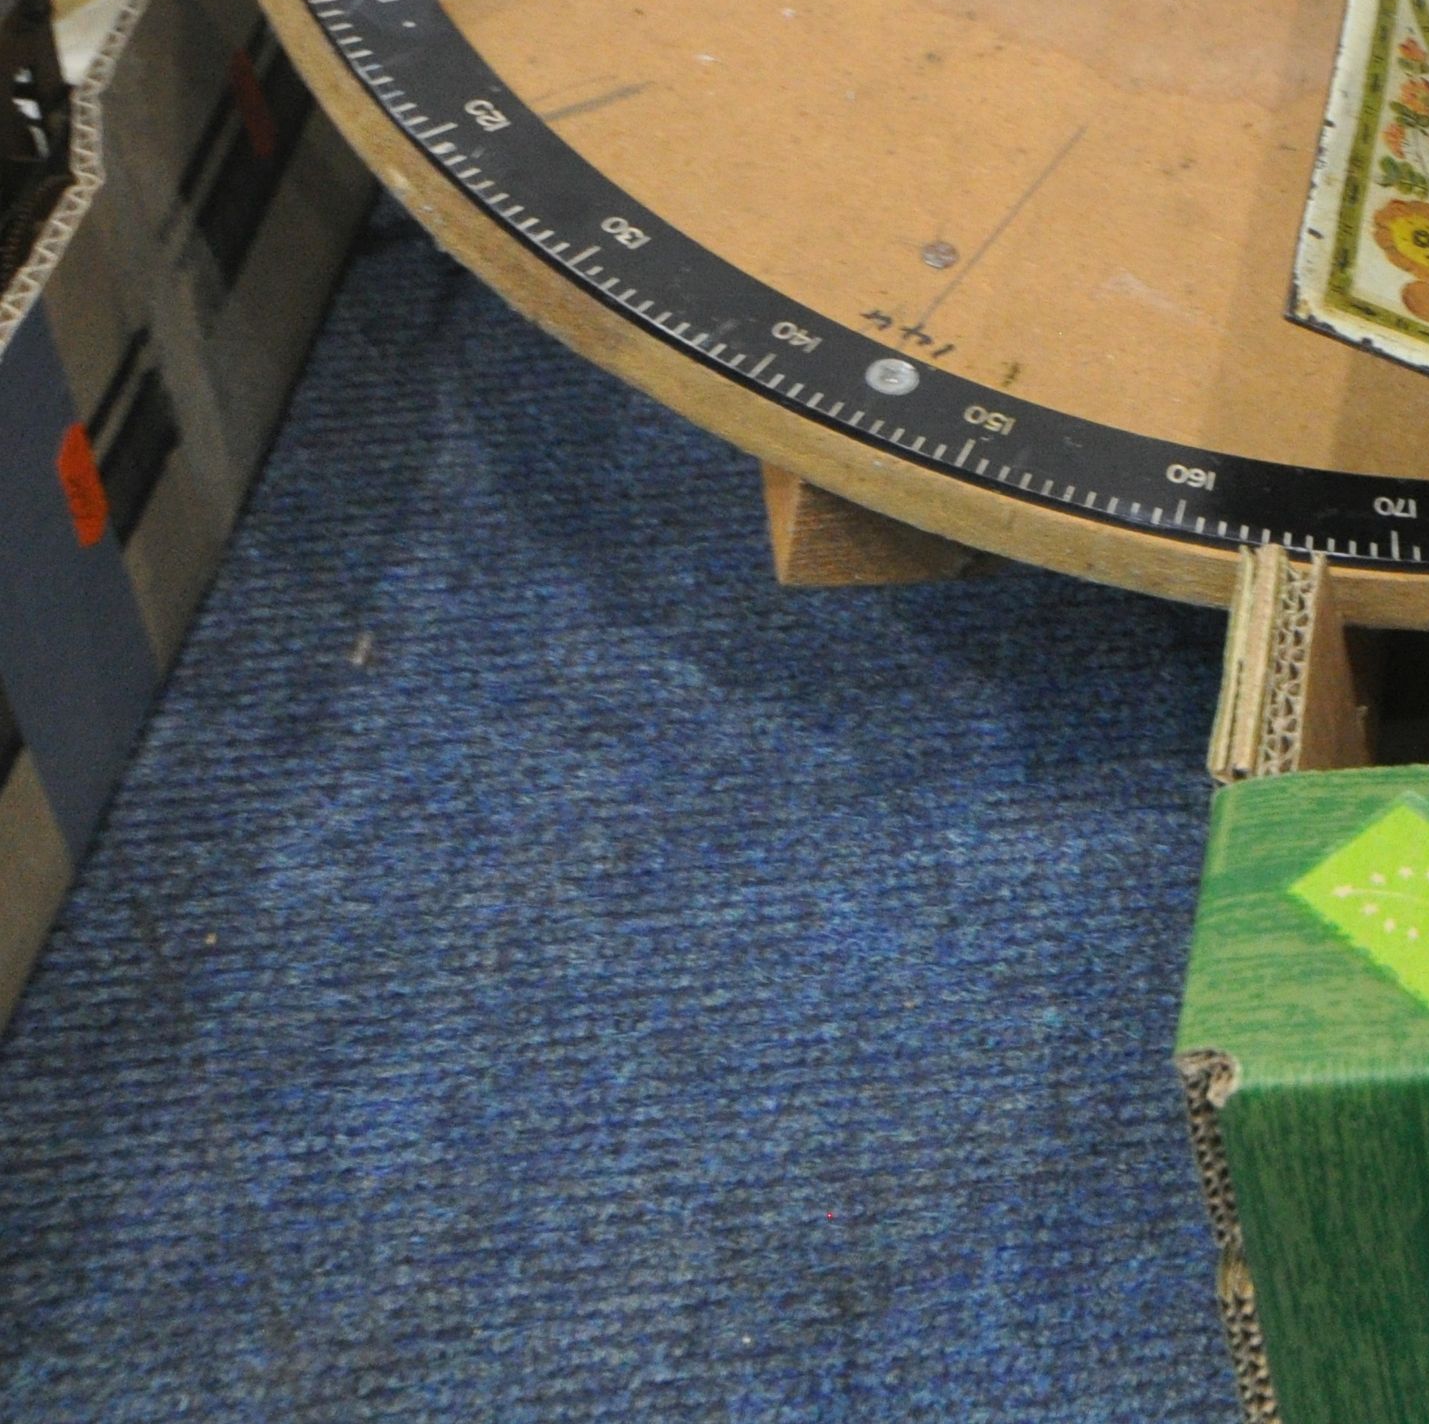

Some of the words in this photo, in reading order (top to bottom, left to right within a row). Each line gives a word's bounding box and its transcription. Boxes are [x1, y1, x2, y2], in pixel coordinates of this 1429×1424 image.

[463, 98, 512, 133] 120
[600, 216, 652, 252] 130
[770, 320, 824, 354] 140
[963, 404, 1016, 437] 150
[1165, 462, 1217, 493] 160
[1372, 496, 1420, 520] 170
